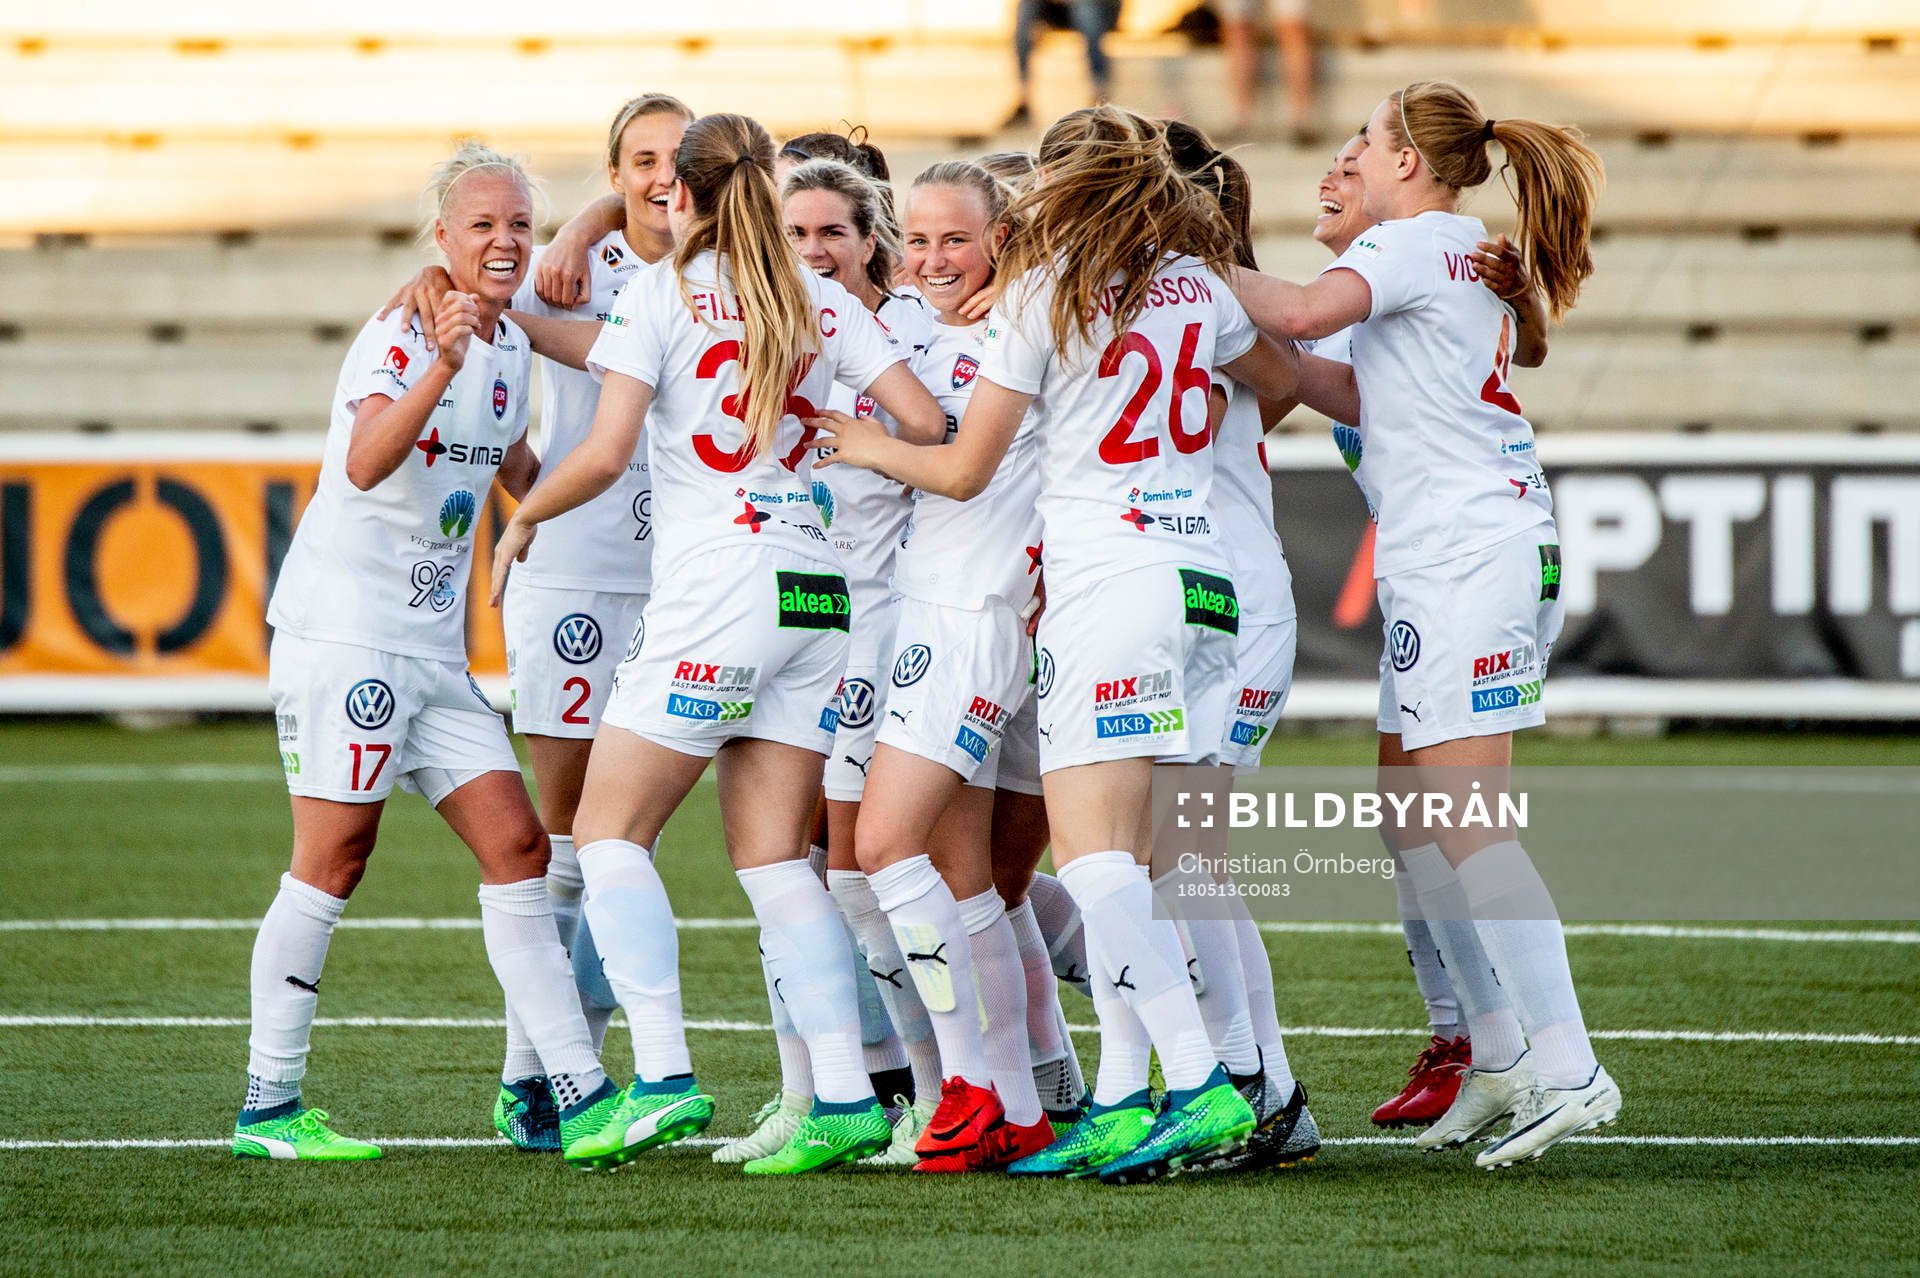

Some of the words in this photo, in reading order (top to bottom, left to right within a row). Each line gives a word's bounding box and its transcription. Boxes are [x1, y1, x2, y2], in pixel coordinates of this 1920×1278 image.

[955, 362, 977, 376] FCR
[1098, 322, 1211, 465] 26
[781, 586, 834, 614] akea
[1185, 582, 1226, 614] akea
[561, 676, 592, 725] 2
[1095, 669, 1172, 703] RIXFM
[1478, 689, 1515, 709] MKB
[673, 697, 716, 718] MKB
[1101, 716, 1146, 735] MKB
[349, 743, 392, 791] 17
